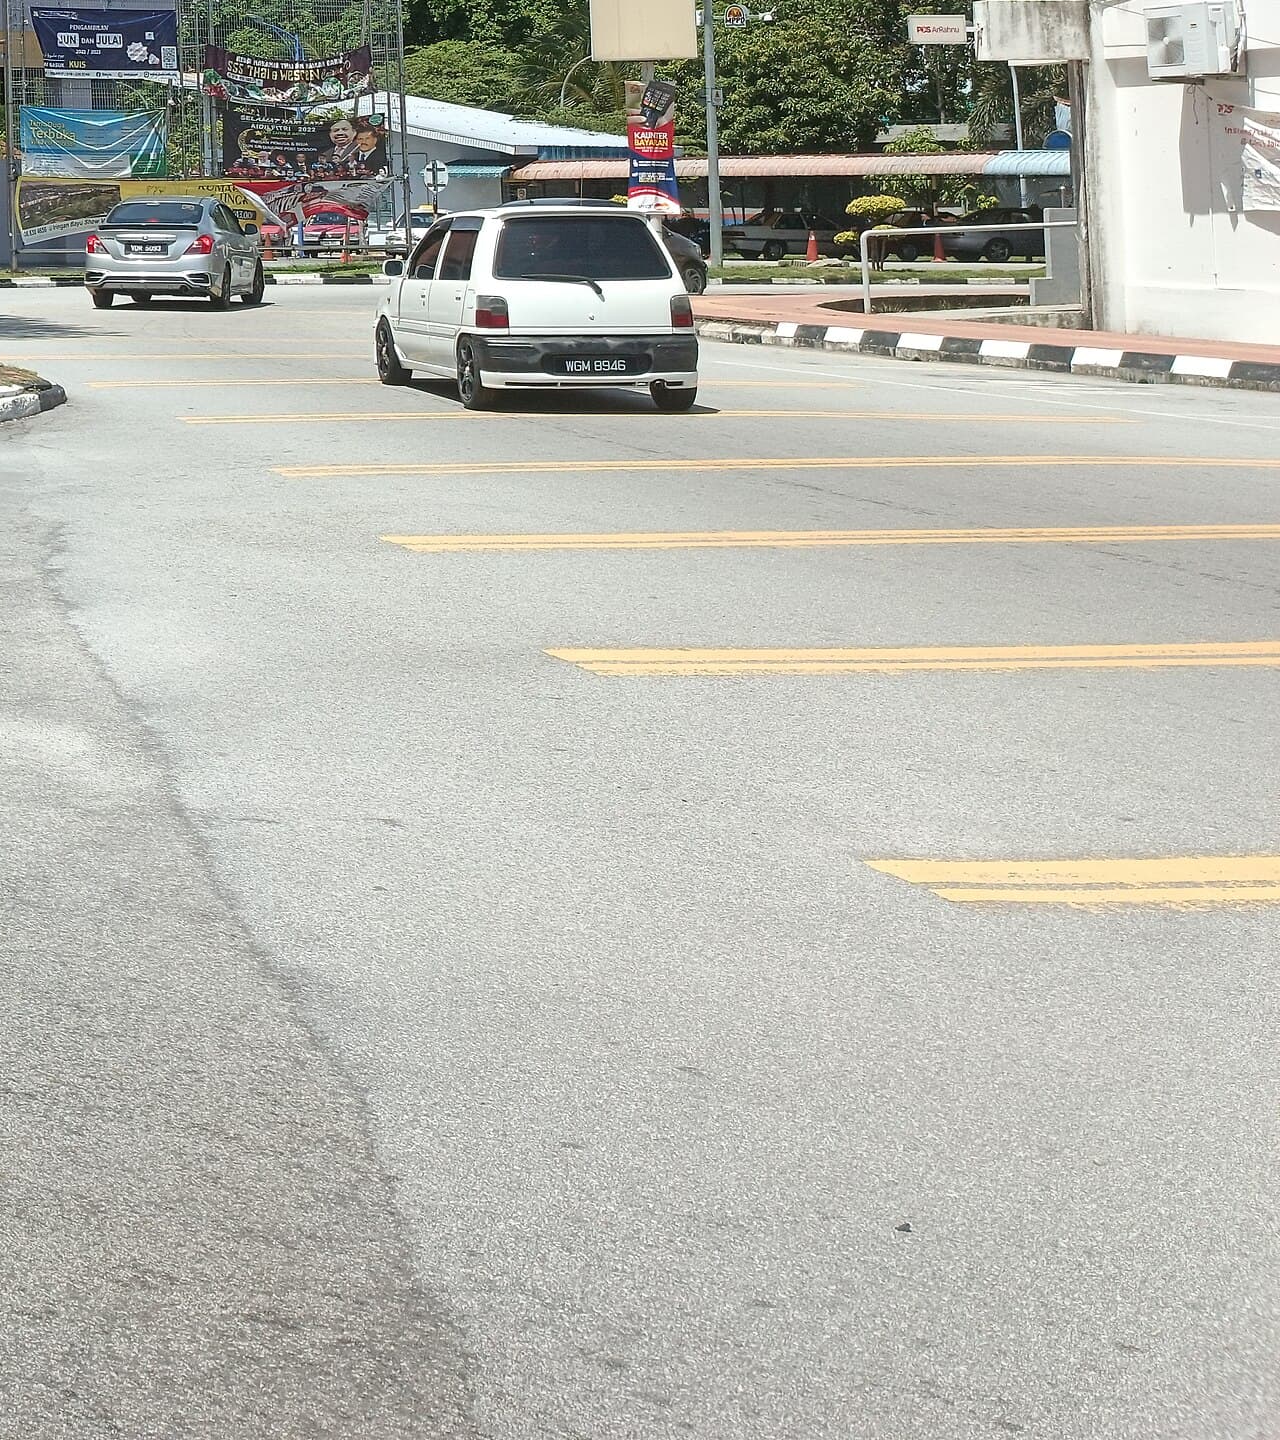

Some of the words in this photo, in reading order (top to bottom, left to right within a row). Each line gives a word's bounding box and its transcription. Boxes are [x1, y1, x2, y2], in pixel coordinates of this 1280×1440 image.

[59, 34, 77, 45] JUN
[97, 34, 122, 45] JULAI
[68, 60, 87, 69] KUIS
[29, 126, 76, 140] Terbuka
[634, 131, 668, 140] KAUNTER
[634, 139, 668, 147] BAYARAN
[565, 360, 591, 372] WGM
[594, 359, 626, 371] 8946
